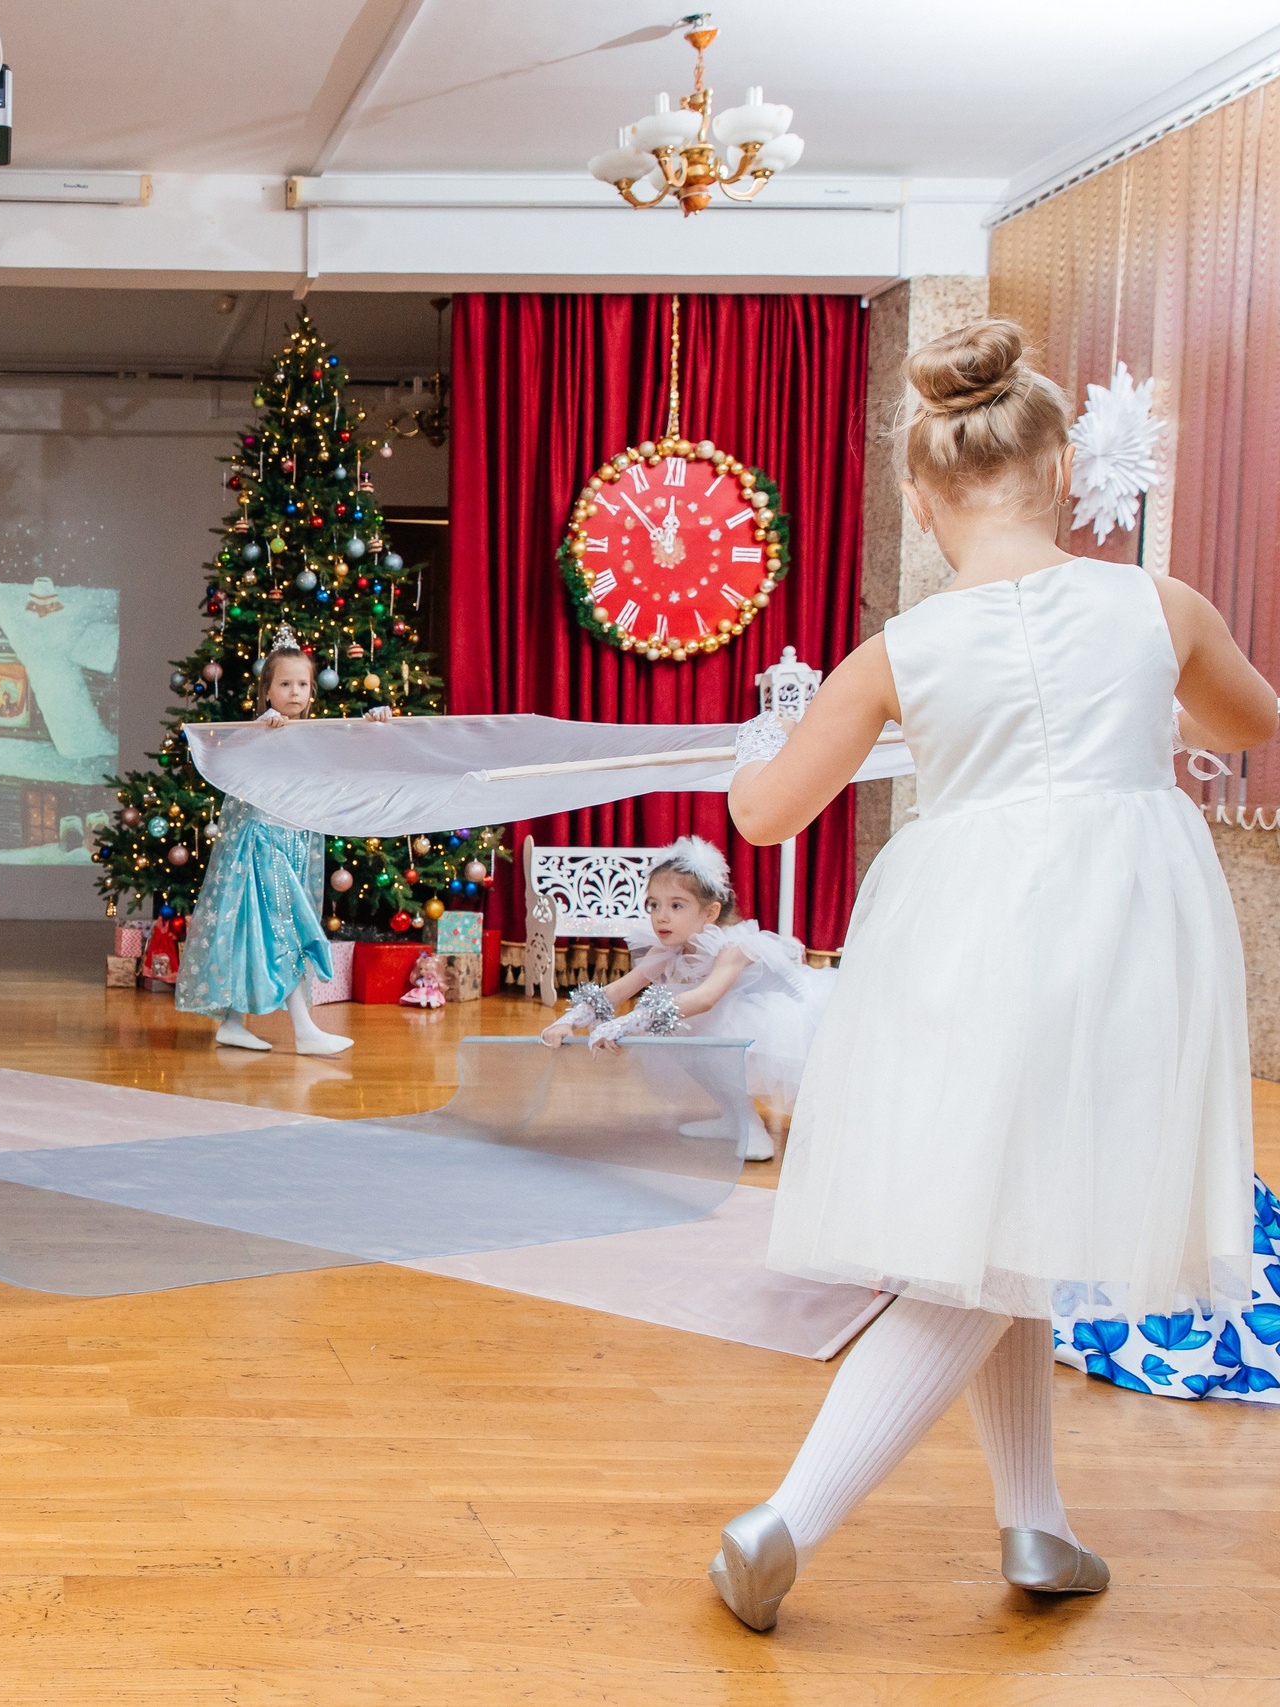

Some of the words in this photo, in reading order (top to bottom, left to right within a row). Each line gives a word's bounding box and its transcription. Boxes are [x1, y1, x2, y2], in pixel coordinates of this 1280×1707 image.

[626, 463, 650, 494] XI
[663, 457, 686, 487] XII
[594, 493, 620, 516] X
[725, 507, 755, 530] II
[586, 536, 609, 553] IX
[731, 546, 762, 563] III
[591, 567, 618, 603] VIII
[614, 599, 640, 633] VII
[694, 609, 711, 636] V
